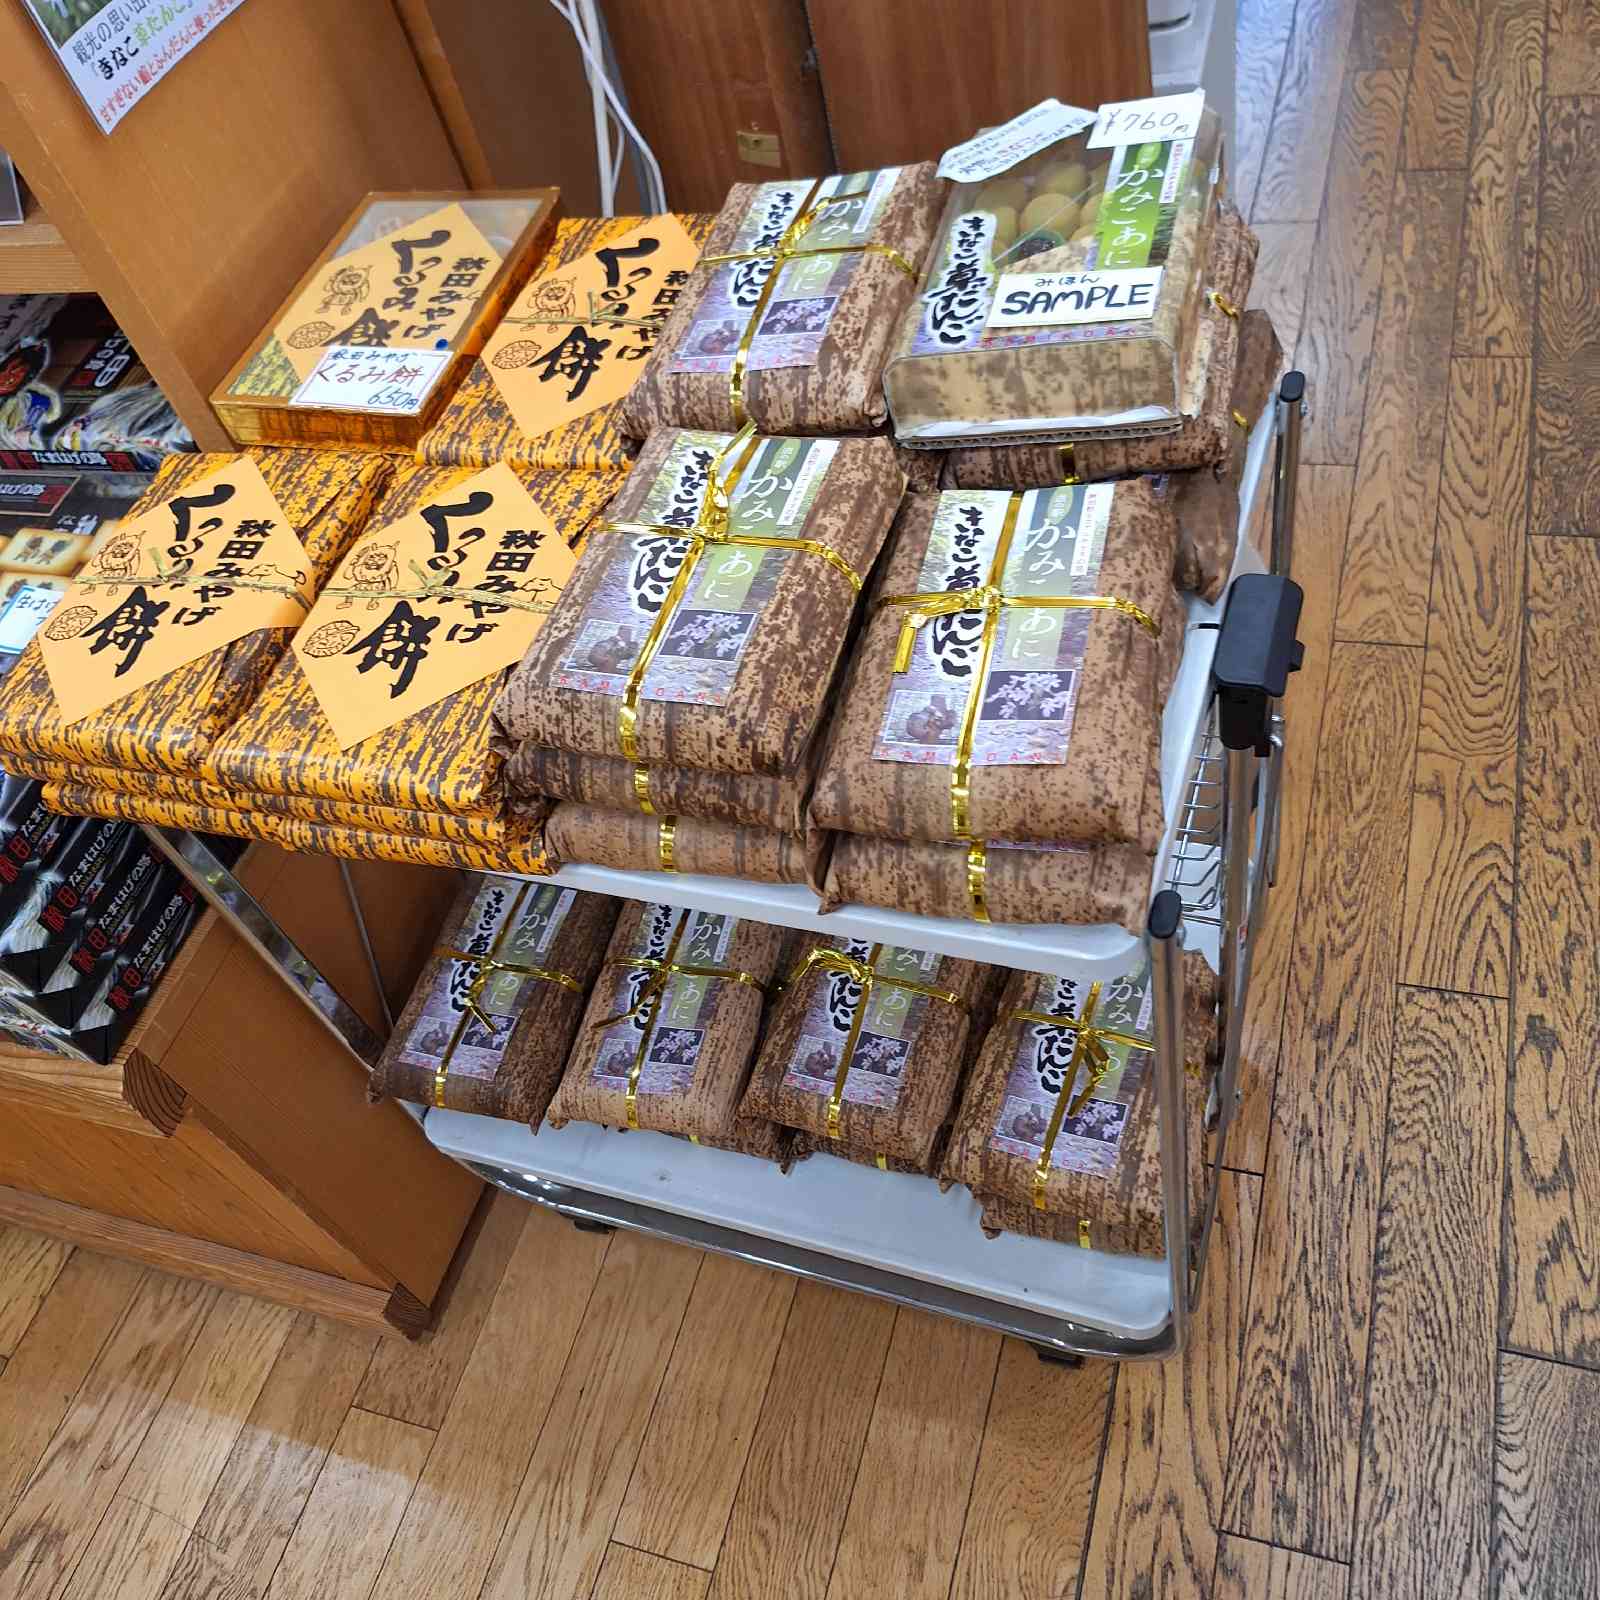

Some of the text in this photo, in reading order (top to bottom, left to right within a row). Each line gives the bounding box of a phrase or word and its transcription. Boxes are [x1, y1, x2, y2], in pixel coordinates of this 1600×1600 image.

[72, 0, 151, 65] 観光の思い出
[1104, 165, 1165, 266] かみこあに
[403, 257, 489, 339] 秋田みやげ
[1001, 283, 1153, 316] SAMPLE
[1035, 274, 1101, 287] みほん
[317, 363, 425, 388] くるみ餅
[367, 385, 420, 410] 650円
[171, 518, 277, 627] 秋田みやげ
[446, 529, 548, 643] 秋田みやげ
[68, 820, 122, 888] なまはげの
